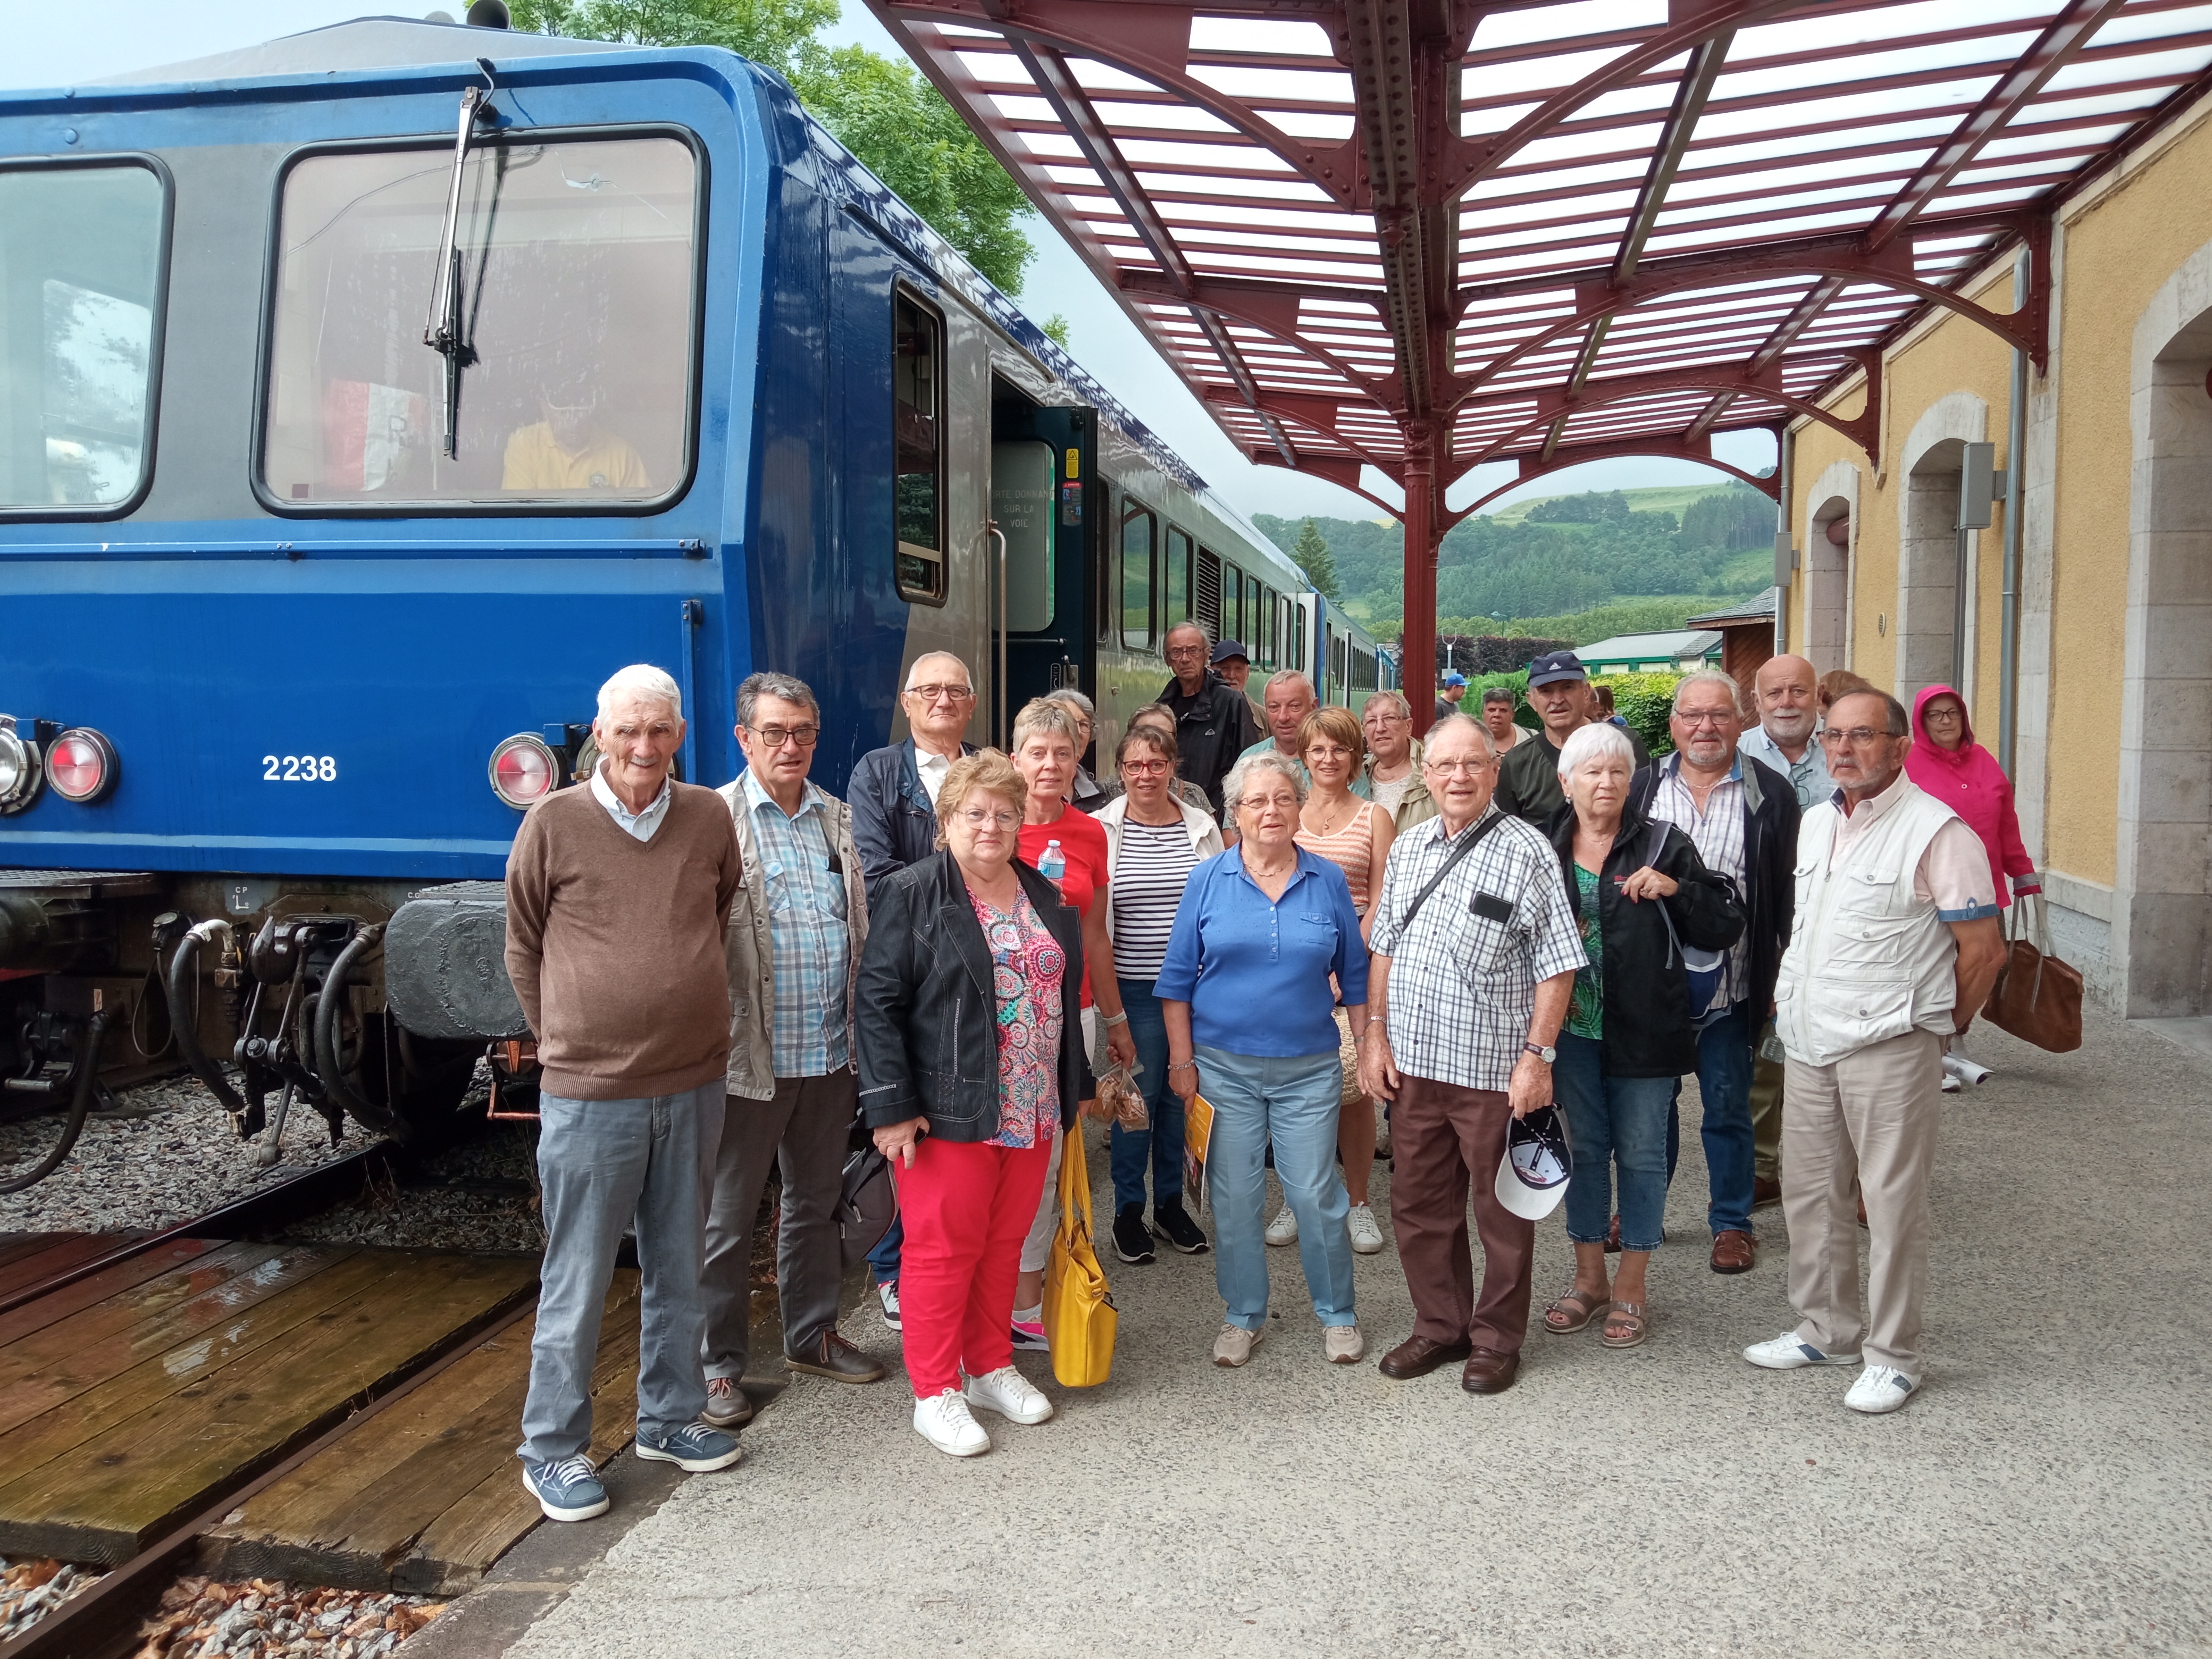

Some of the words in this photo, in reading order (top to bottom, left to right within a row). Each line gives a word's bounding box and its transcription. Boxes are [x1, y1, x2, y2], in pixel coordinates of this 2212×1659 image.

[991, 490, 1011, 499] ORTE
[1015, 490, 1055, 499] DONNANT
[1004, 505, 1021, 513] SUR
[1024, 505, 1034, 513] LA
[1010, 519, 1028, 527] VOIE
[262, 755, 337, 782] 2238
